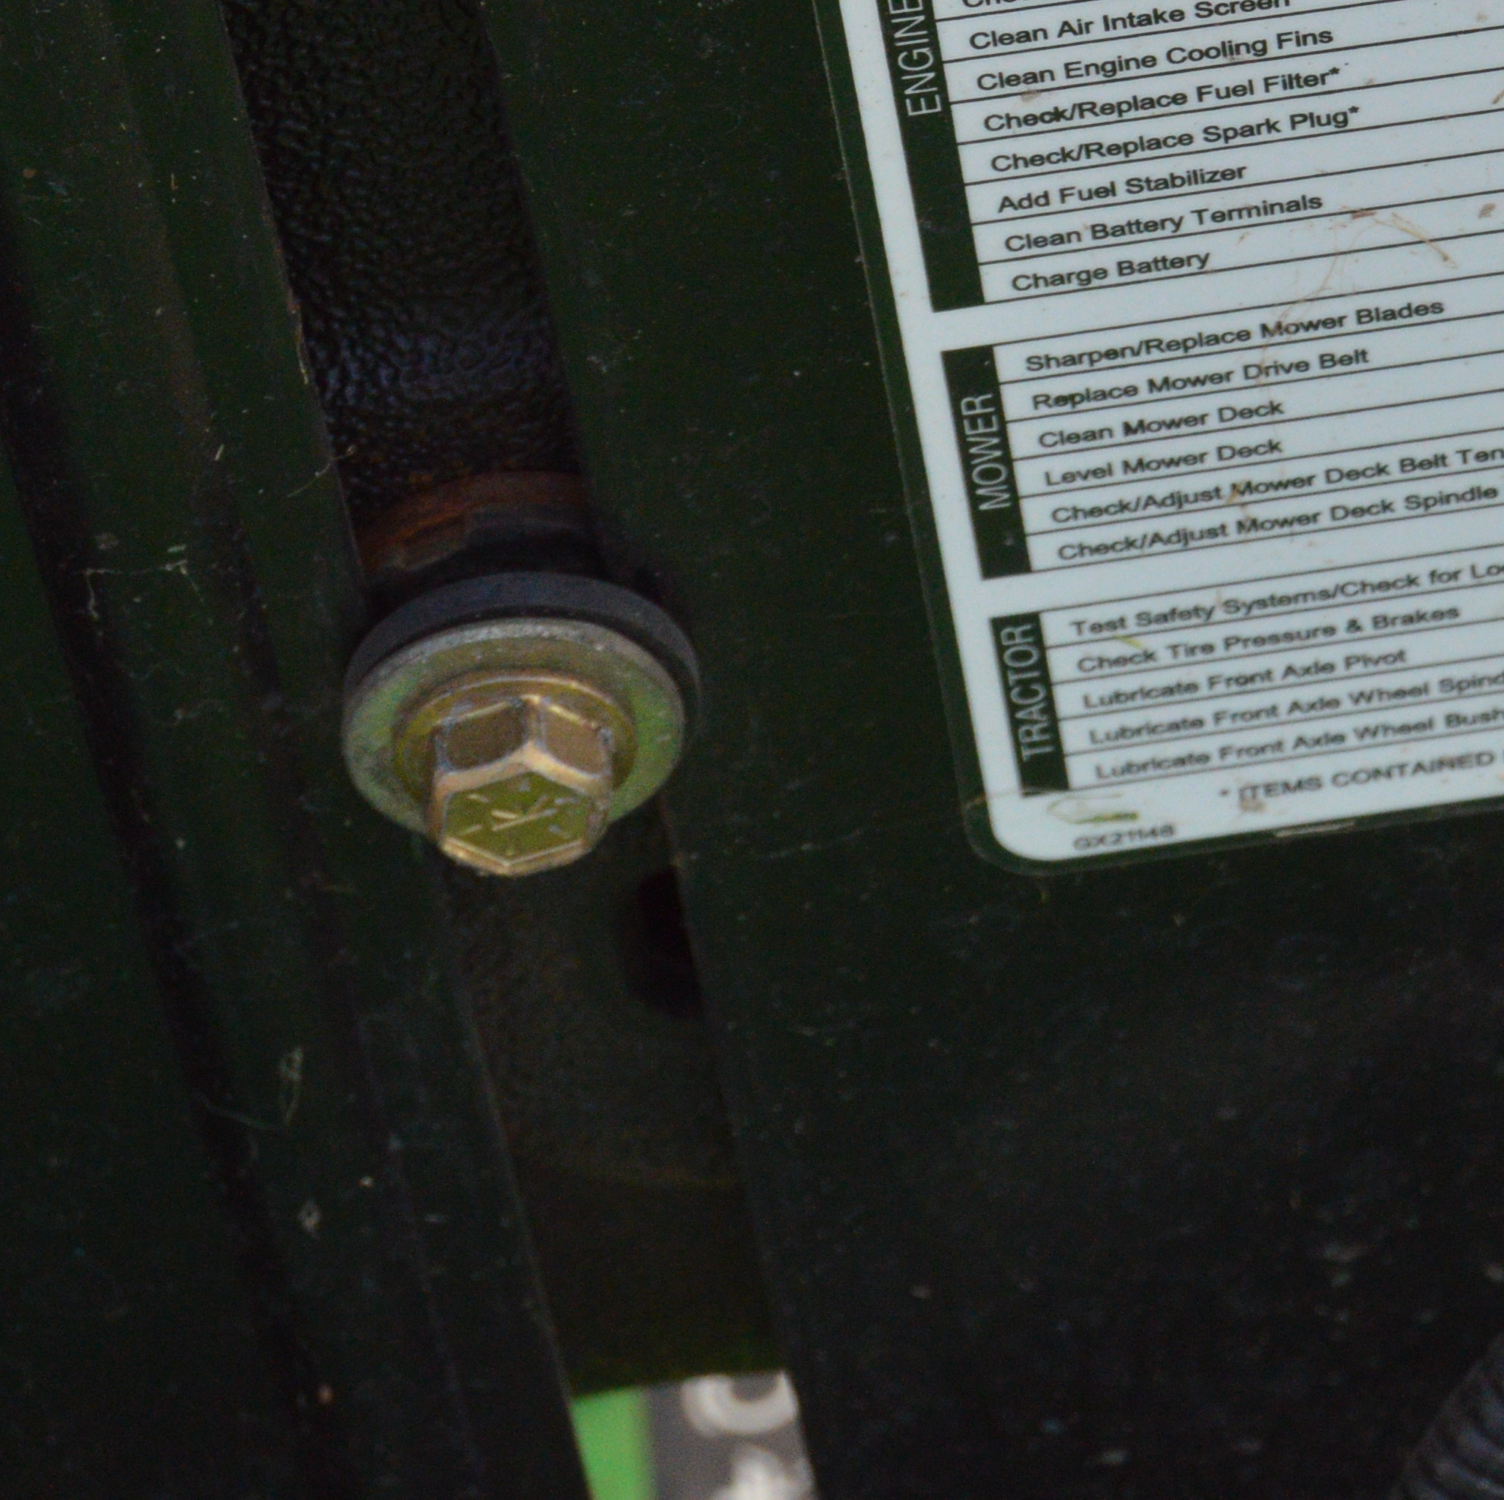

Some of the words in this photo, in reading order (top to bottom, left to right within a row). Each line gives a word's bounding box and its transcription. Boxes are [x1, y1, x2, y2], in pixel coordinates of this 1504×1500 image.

[968, 26, 1049, 50] Clean
[1056, 17, 1095, 39] Air
[1101, 6, 1186, 32] Intake
[975, 68, 1056, 91] Clean
[1062, 54, 1158, 80] Engine
[1164, 38, 1268, 65] Cooling
[1275, 29, 1334, 50] Fins
[982, 91, 1188, 132] Check/Replace
[1194, 78, 1255, 103] Fuel
[989, 132, 1194, 172] Check/Replace
[1201, 117, 1282, 145] Spark
[996, 189, 1051, 213] Add
[1057, 179, 1117, 204] Fuel
[1123, 165, 1247, 195] Stabilizer
[1003, 229, 1082, 252] Clean
[1088, 215, 1184, 241] Battery
[1189, 193, 1323, 226] Terminals
[1010, 266, 1109, 292] Charge
[1115, 251, 1210, 277] Battery
[1024, 328, 1252, 372] Sharpen/Replace
[1258, 314, 1348, 339] Mower
[1354, 301, 1445, 325] Blades
[1031, 383, 1139, 410] Replace
[1145, 369, 1234, 394] Mower
[1241, 359, 1310, 381] Drive
[1317, 347, 1369, 370] Belt
[959, 392, 1011, 511] MOWER
[1037, 426, 1114, 448] Clean
[1121, 412, 1209, 437] Mower
[1216, 399, 1284, 423] Deck
[1070, 615, 1127, 636] Test
[1134, 604, 1216, 627] Safety
[1220, 573, 1420, 615] Systems/Check
[1427, 568, 1462, 585] for
[999, 623, 1053, 761] TRACTOR
